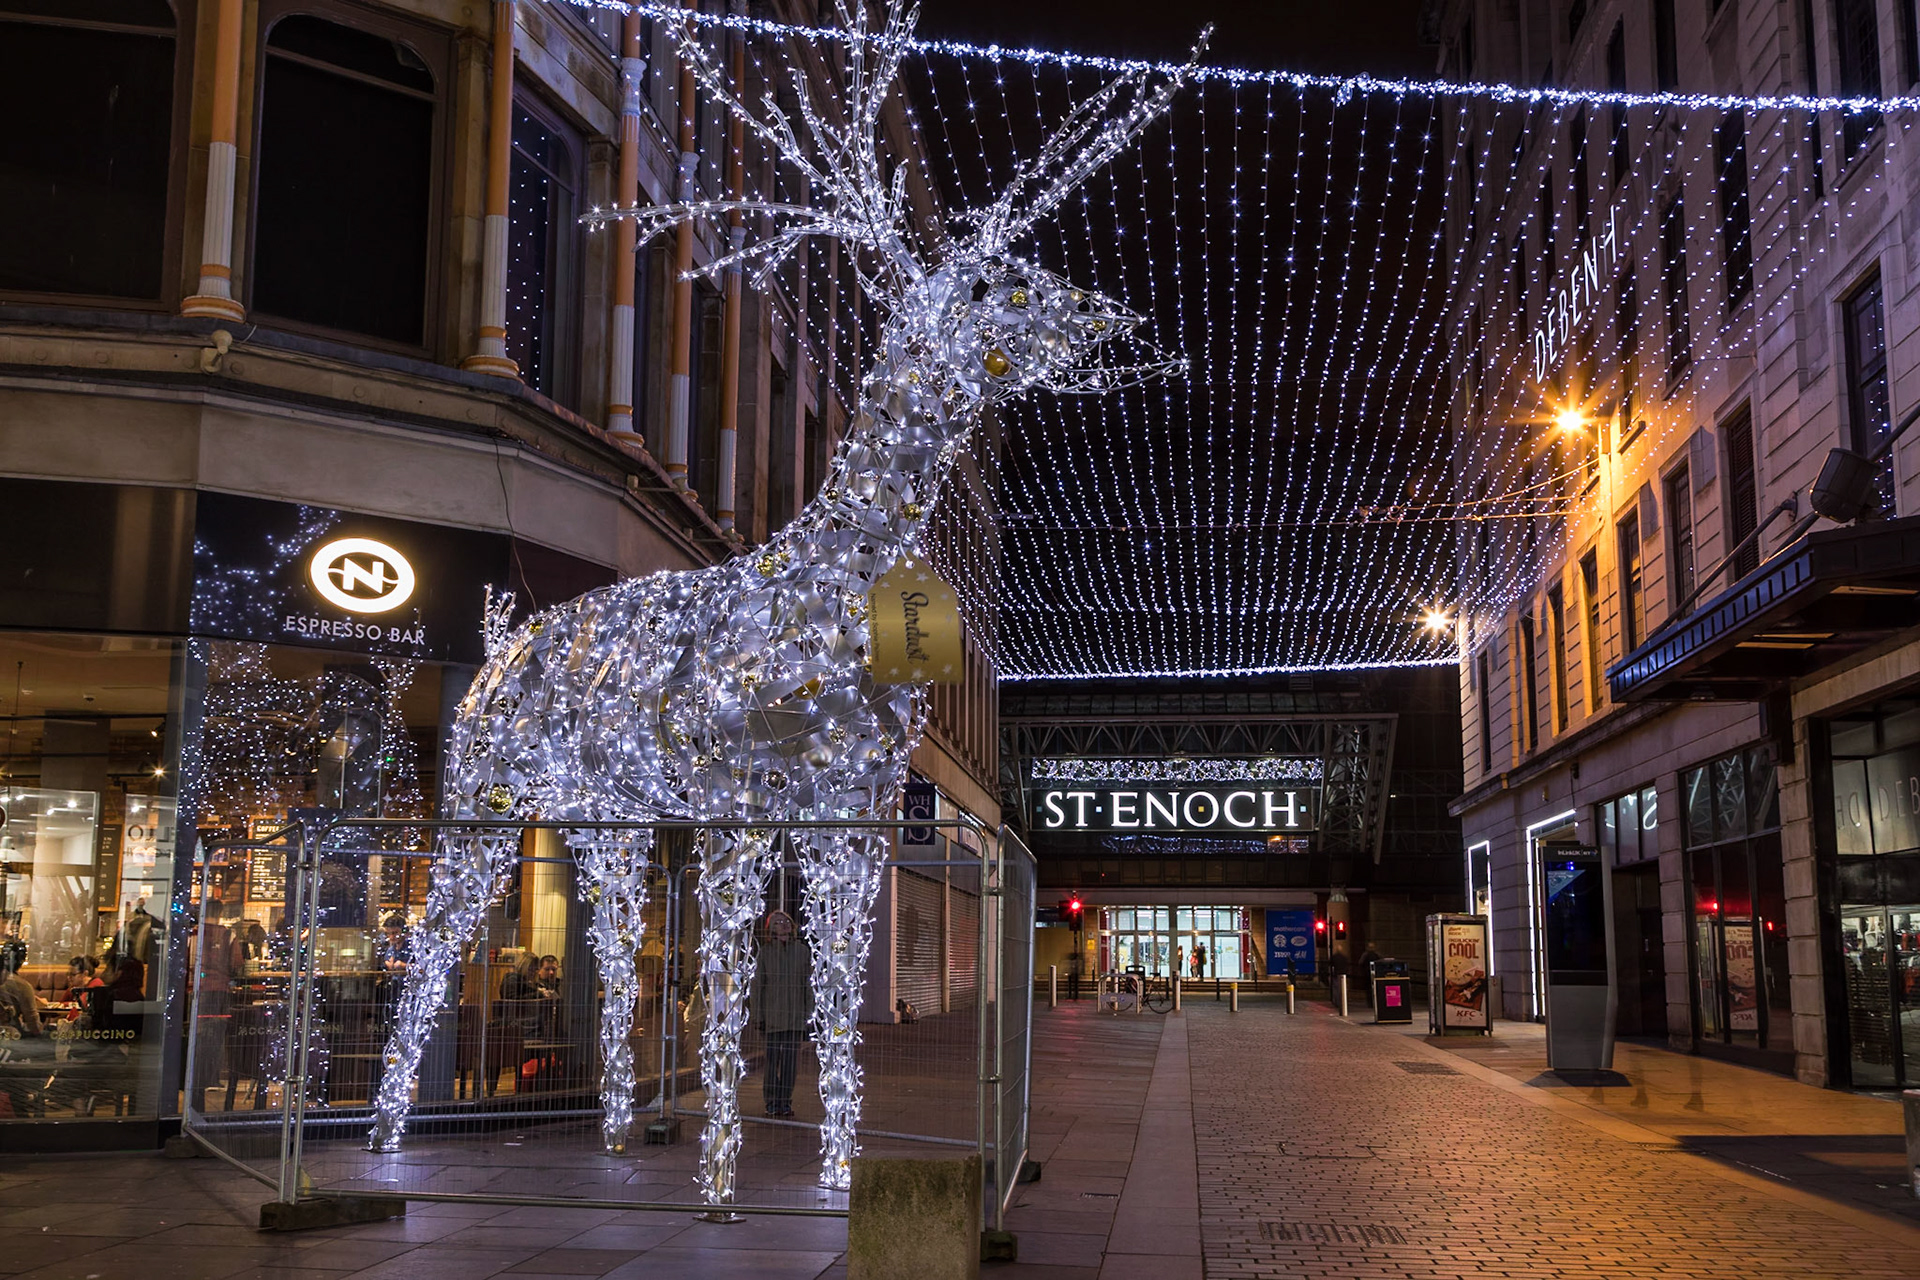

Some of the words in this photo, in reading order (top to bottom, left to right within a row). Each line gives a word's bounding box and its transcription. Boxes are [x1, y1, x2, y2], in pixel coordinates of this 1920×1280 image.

[1535, 205, 1617, 384] DEBENH
[285, 615, 381, 642] ESPRESSO
[389, 627, 425, 645] BAR
[901, 590, 930, 664] Stardust
[908, 795, 931, 806] WH
[1045, 791, 1096, 828] ST
[1110, 791, 1299, 828] ENOCH
[1449, 943, 1479, 959] COOL
[50, 1029, 136, 1040] CAPPUCCINO
